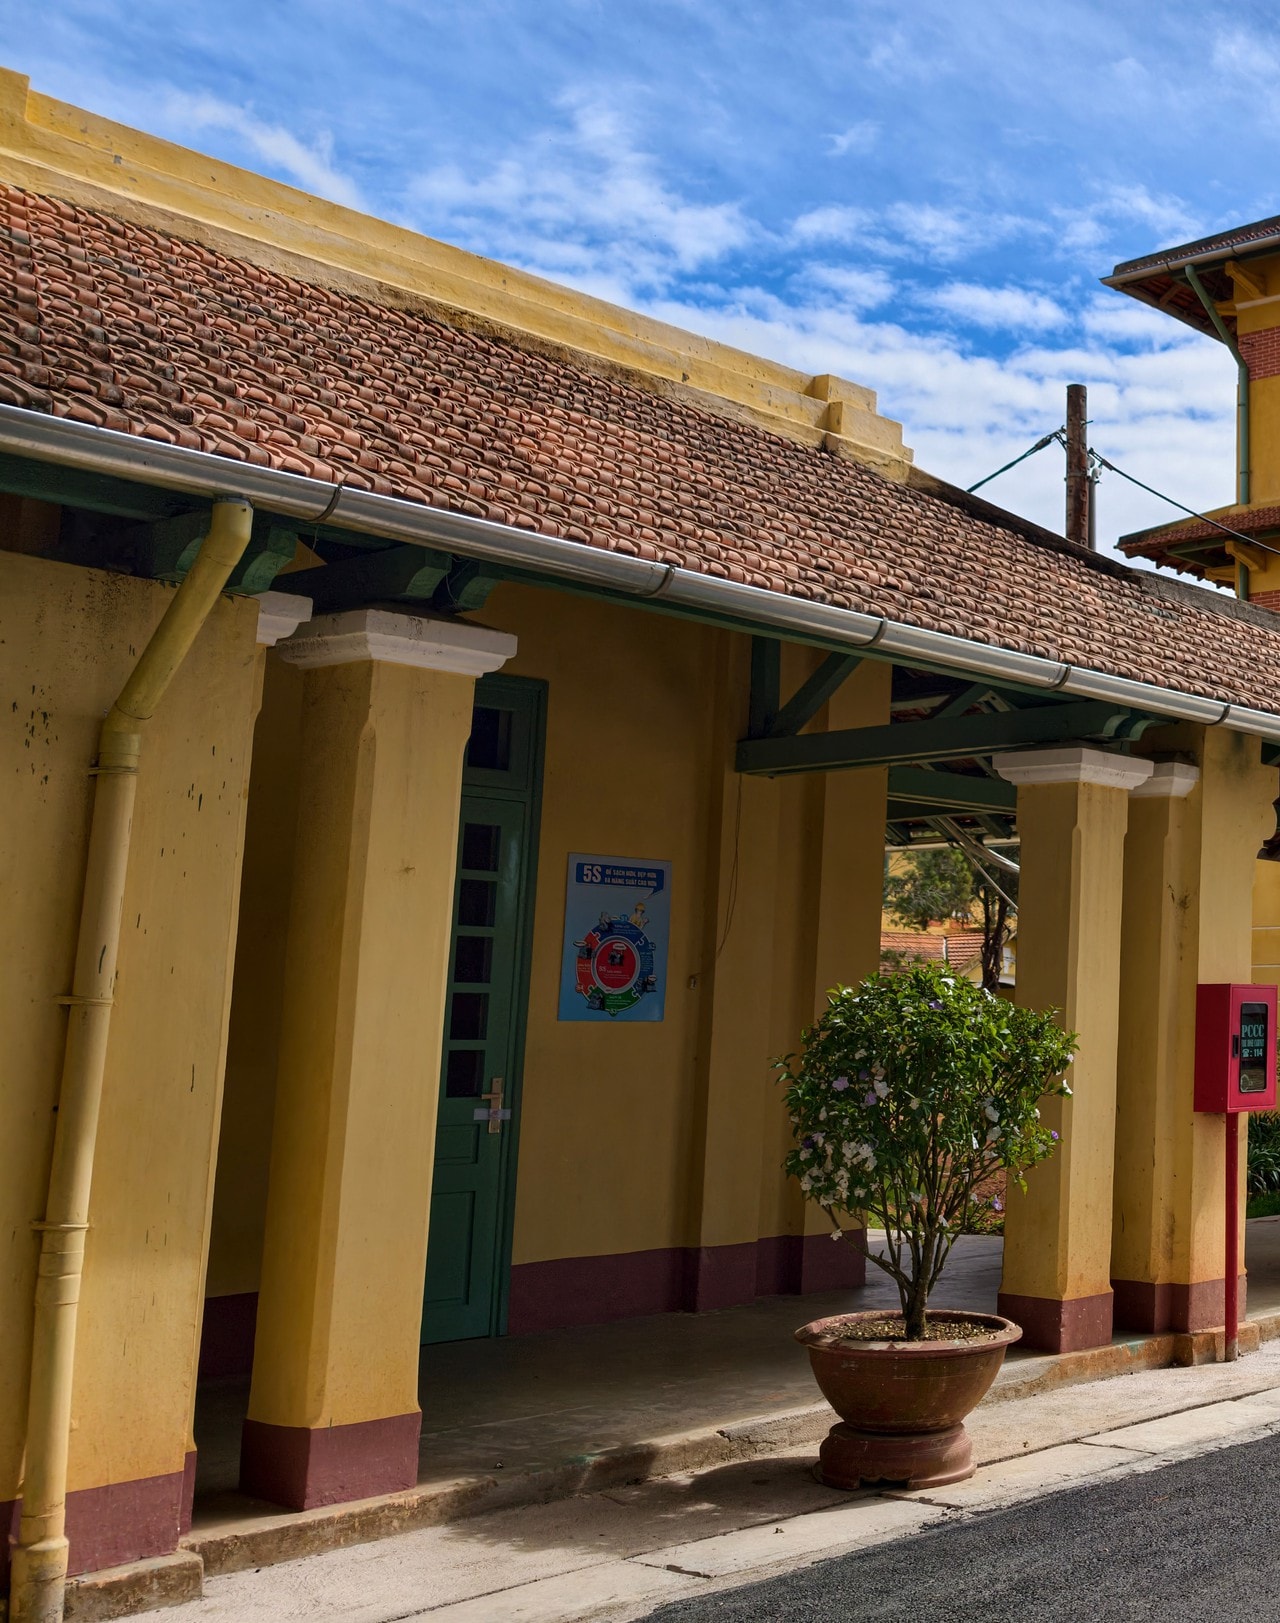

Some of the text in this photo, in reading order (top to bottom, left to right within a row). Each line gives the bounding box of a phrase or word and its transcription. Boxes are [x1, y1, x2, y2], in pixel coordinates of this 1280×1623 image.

[583, 865, 602, 883] 5S
[1241, 1024, 1265, 1038] PCCC
[1254, 1048, 1263, 1057] 114
